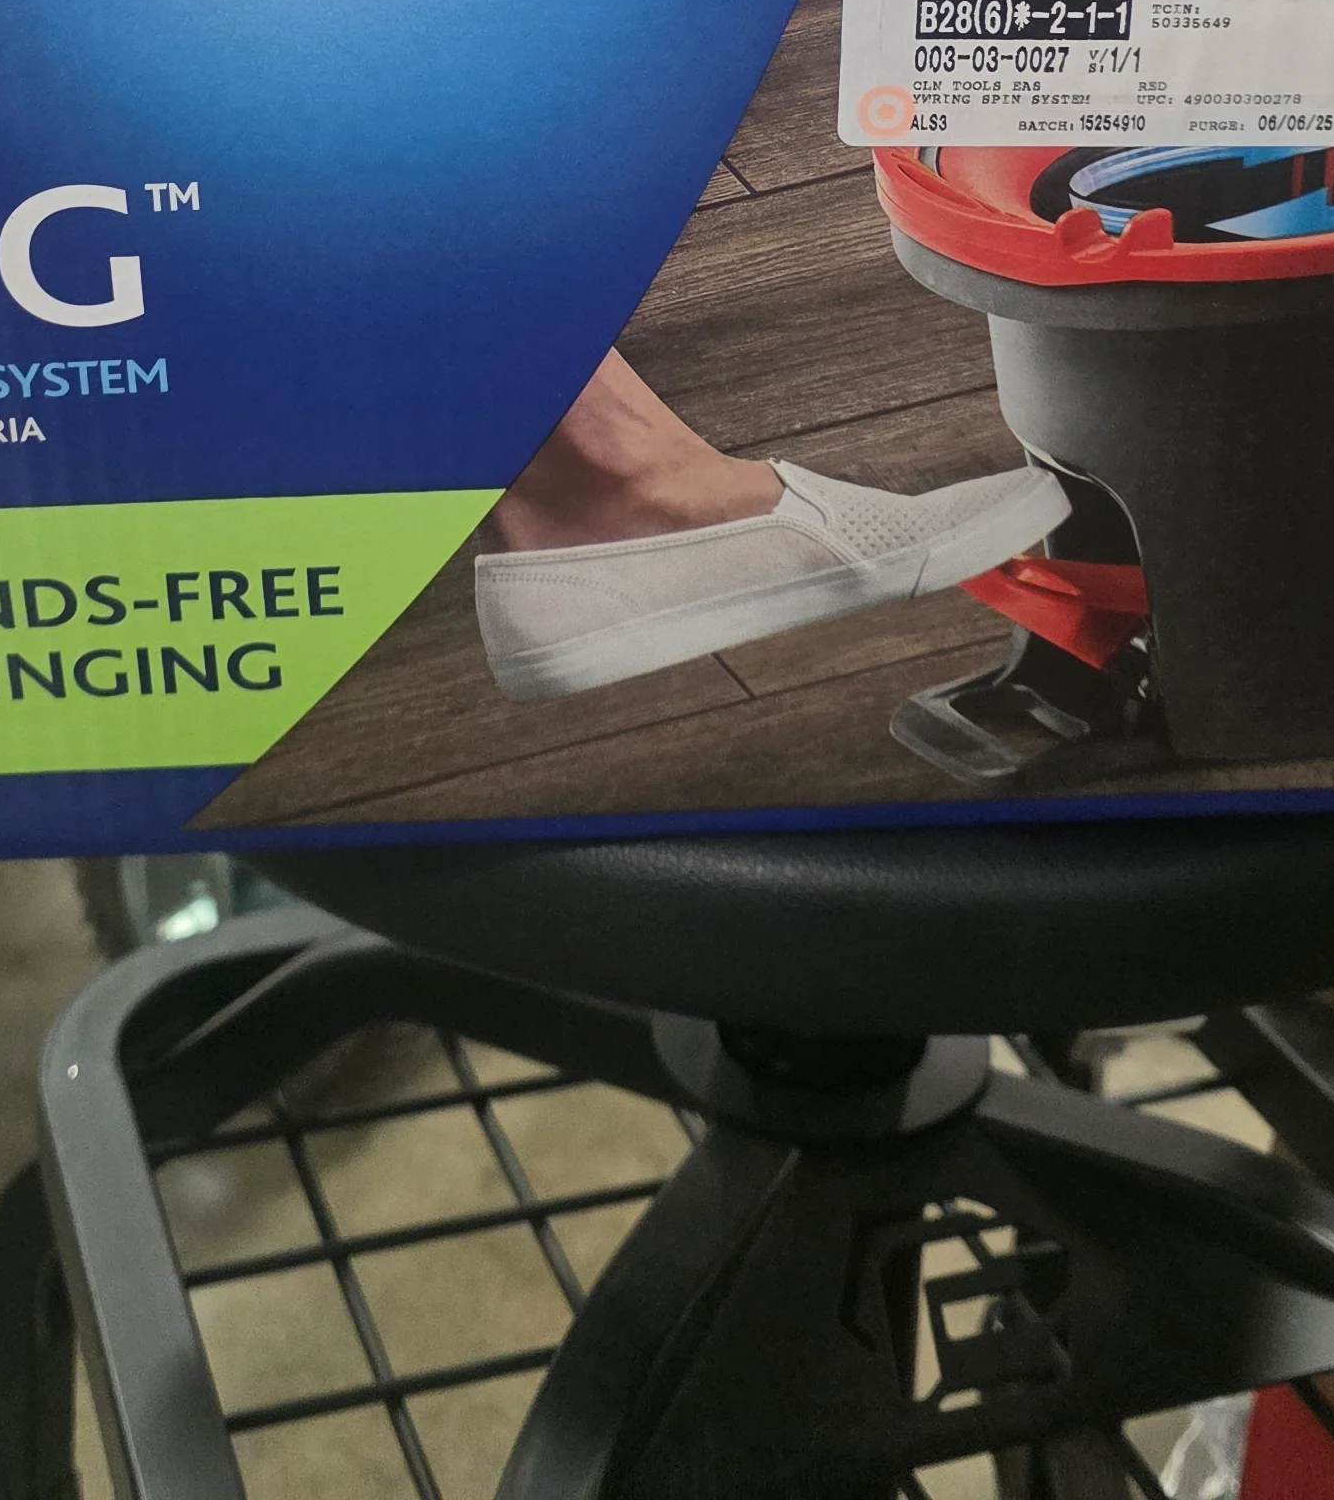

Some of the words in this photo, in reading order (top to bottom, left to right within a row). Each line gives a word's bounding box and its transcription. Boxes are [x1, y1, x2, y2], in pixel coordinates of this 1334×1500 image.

[1152, 4, 1201, 15] TCIN:
[1151, 17, 1231, 29] 50335649
[914, 45, 1070, 74] 003-03-0027
[913, 81, 942, 91] CLN
[952, 81, 1001, 91] TOOLS
[1012, 81, 1041, 91] EAS
[982, 94, 1021, 105] SPIN
[1031, 94, 1091, 105] SYSTEM
[1136, 94, 1173, 105] UPC:
[910, 114, 947, 131] ALS3
[1018, 120, 1074, 132] BATCH:
[1079, 114, 1146, 132] 15254910
[1188, 120, 1245, 132] PURGE:
[1257, 114, 1334, 132] 06/06/25
